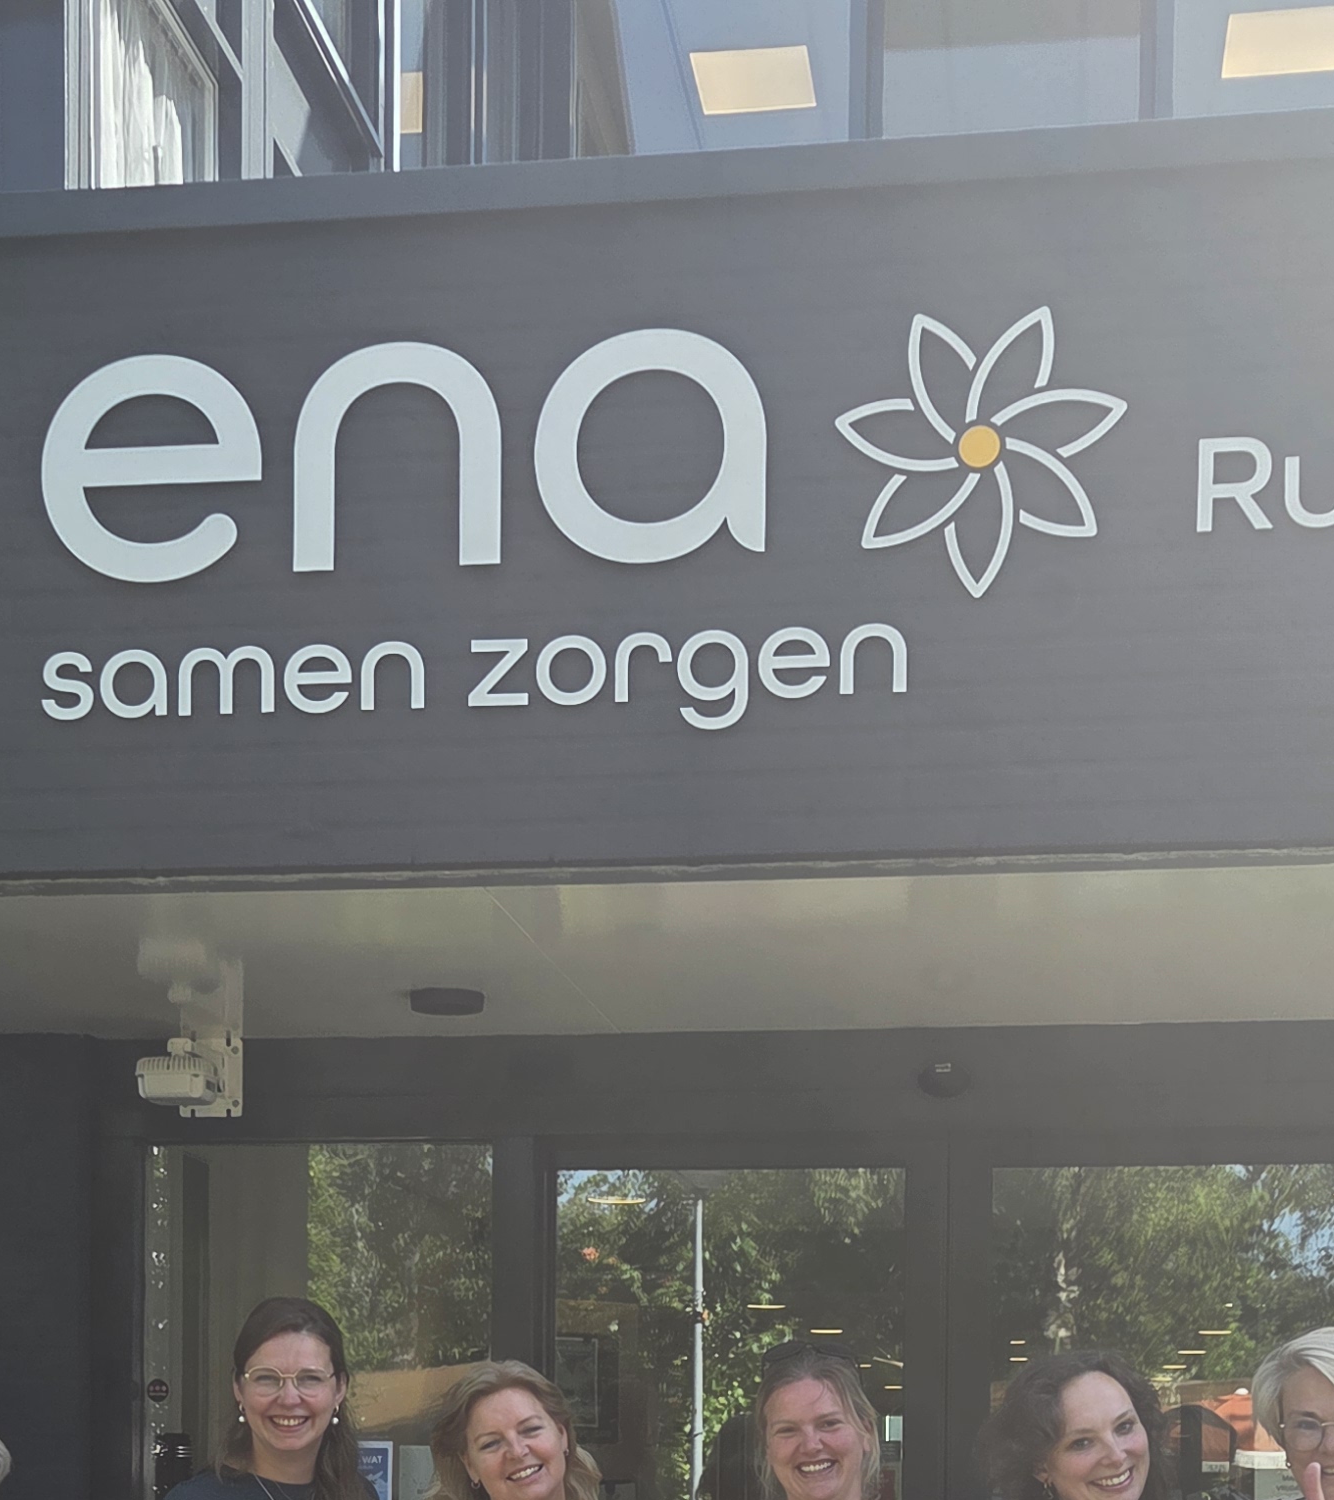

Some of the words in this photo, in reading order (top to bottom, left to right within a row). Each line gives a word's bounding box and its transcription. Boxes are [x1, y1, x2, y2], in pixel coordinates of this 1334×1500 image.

[42, 329, 767, 582] ena
[42, 641, 424, 720] samen
[468, 623, 907, 729] zorgen
[361, 1455, 383, 1464] WAT
